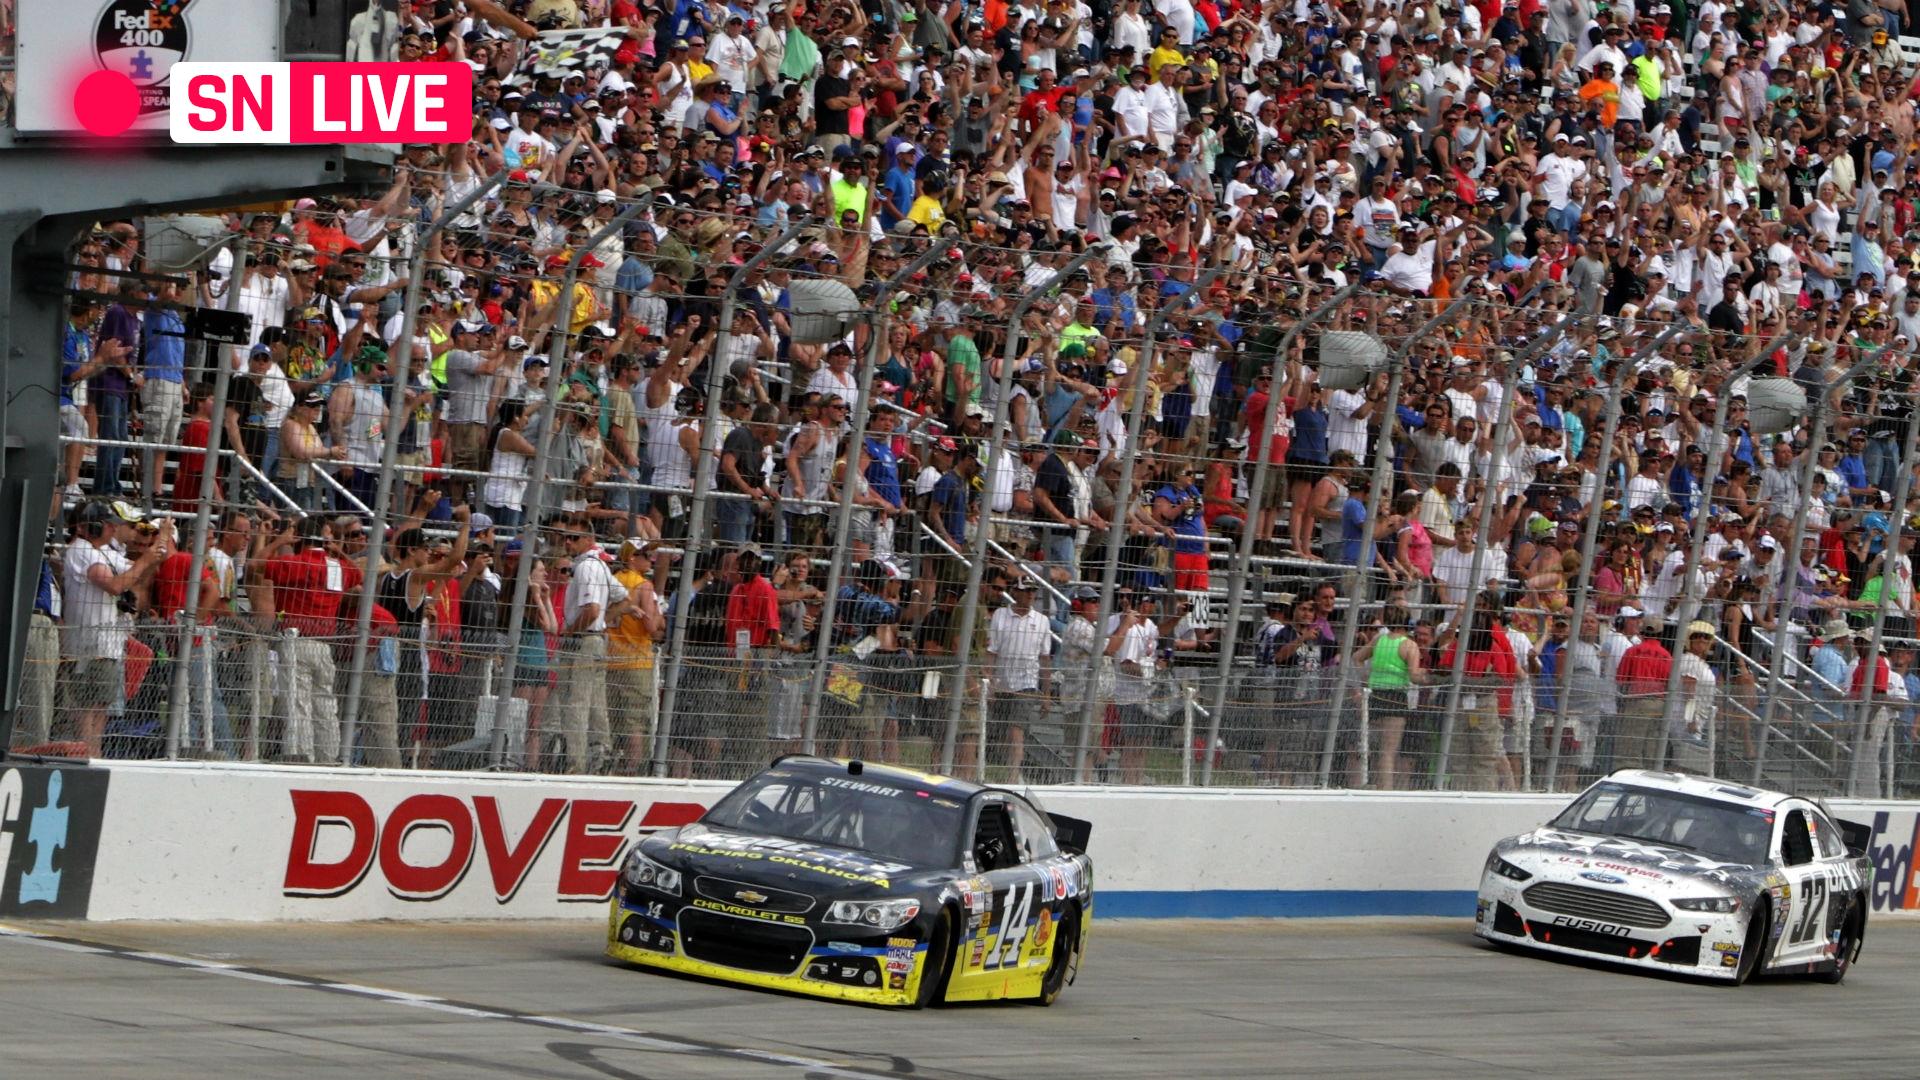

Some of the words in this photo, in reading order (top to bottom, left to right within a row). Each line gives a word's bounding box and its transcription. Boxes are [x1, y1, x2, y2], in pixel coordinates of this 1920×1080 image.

[114, 10, 173, 29] FedEx
[120, 30, 164, 46] 400
[820, 777, 903, 797] STEWART
[669, 843, 762, 859] HELPING
[769, 855, 890, 889] OKLAHOMA
[1595, 861, 1664, 879] CHROME
[1586, 873, 1619, 883] Ford
[647, 901, 663, 919] 14
[693, 899, 780, 921] CHEVROLET
[784, 915, 805, 924] SS
[1789, 872, 1827, 946] 32
[984, 881, 1034, 970] 14
[1553, 915, 1632, 937] FUSION
[888, 938, 917, 948] MOOG
